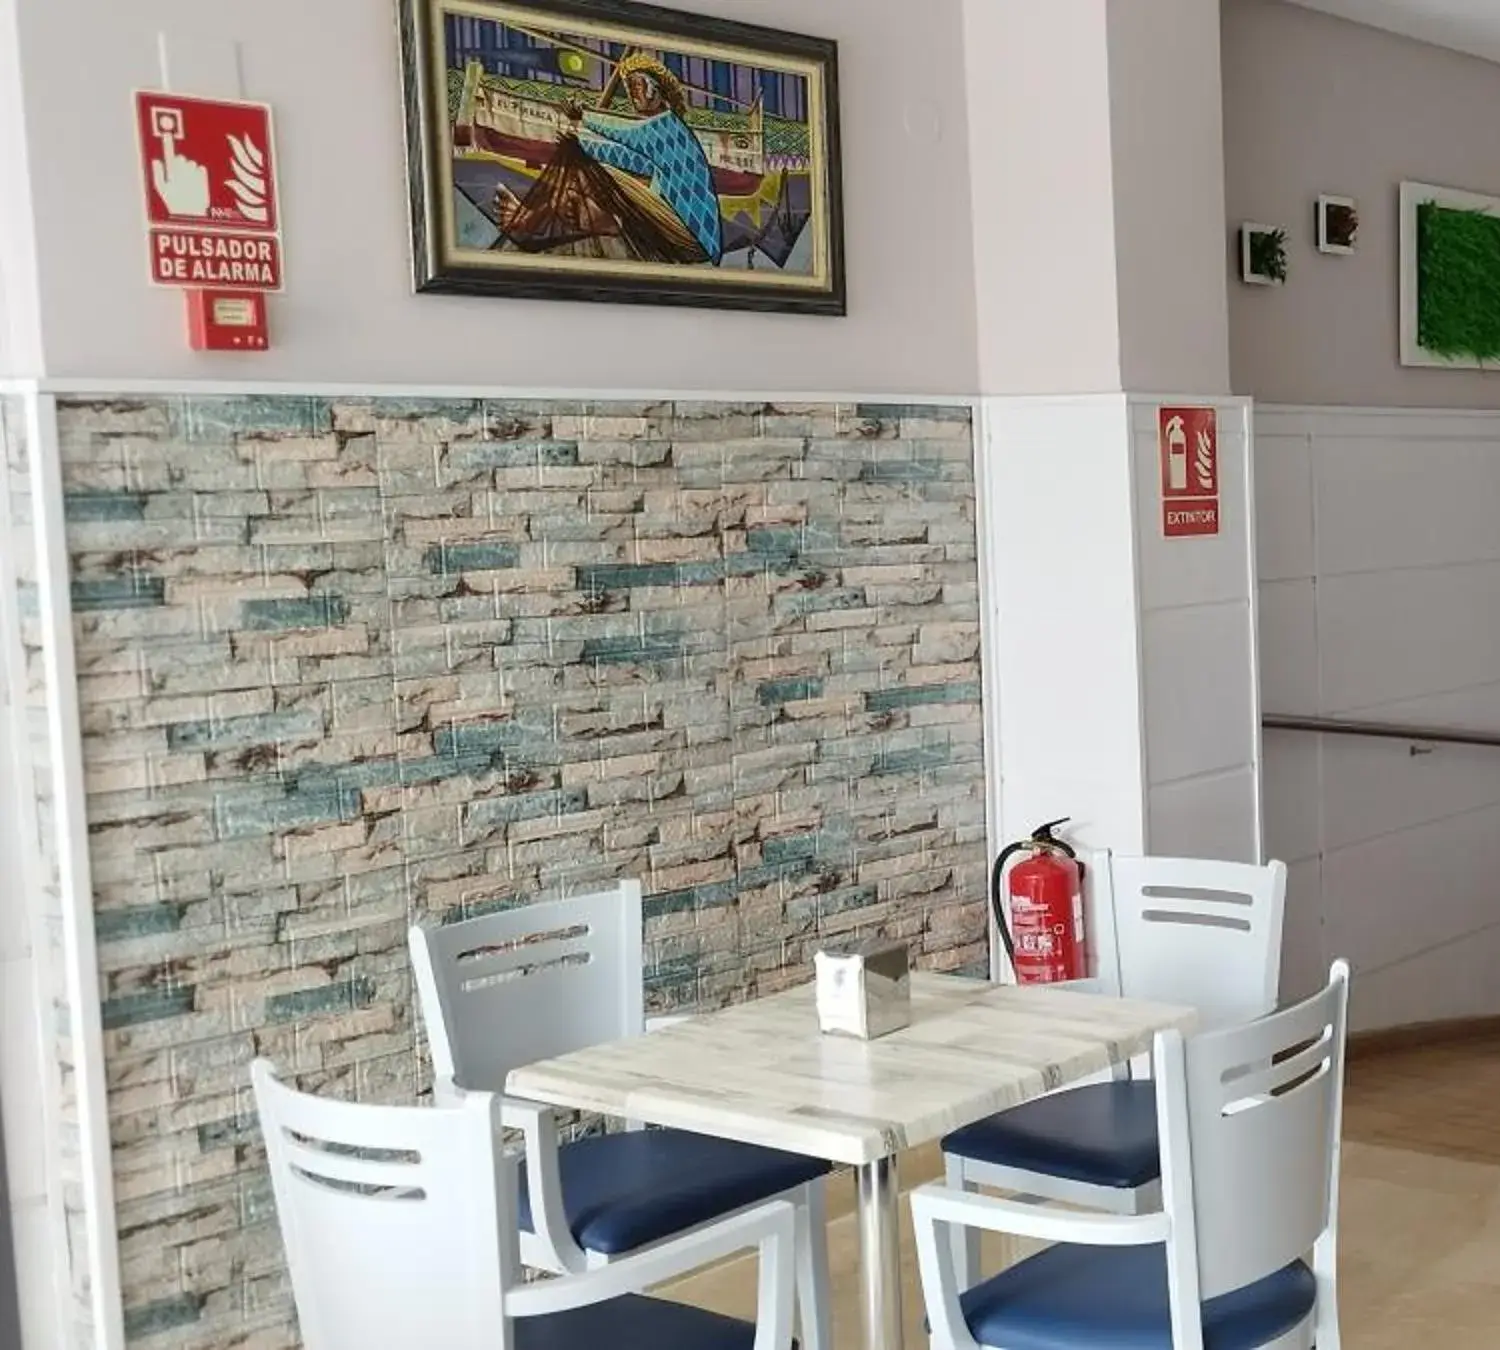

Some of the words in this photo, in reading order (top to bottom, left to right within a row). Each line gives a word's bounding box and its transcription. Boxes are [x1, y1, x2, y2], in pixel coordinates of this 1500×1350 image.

[158, 234, 272, 260] PULSADOR
[160, 258, 188, 277] DE
[192, 260, 274, 282] ALARMA
[1167, 511, 1216, 525] EXTINTOR
